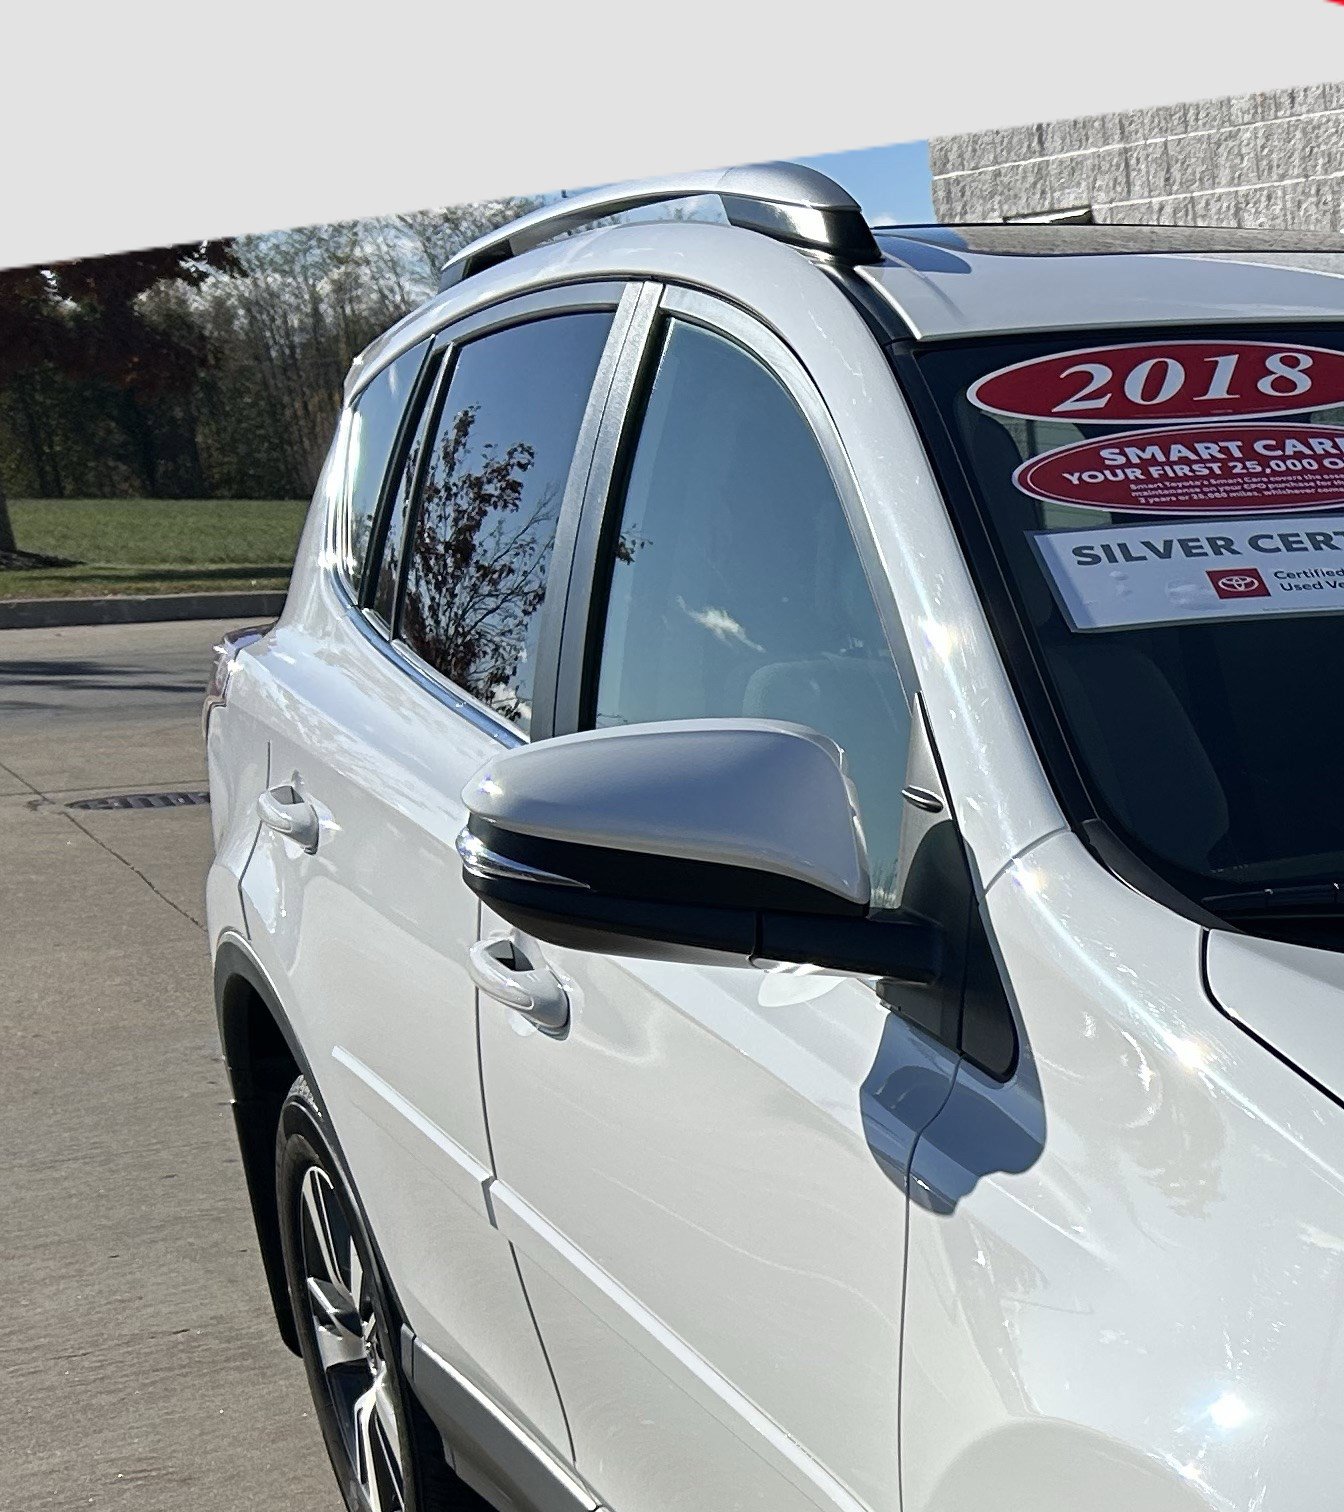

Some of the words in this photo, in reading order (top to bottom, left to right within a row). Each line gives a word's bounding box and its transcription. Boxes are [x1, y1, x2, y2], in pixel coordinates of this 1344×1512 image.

[1052, 352, 1313, 413] 2018
[1100, 441, 1243, 465] SMART
[1062, 467, 1146, 485] YOUR
[1148, 463, 1222, 478] FIRST
[1228, 458, 1319, 474] 25,000
[1072, 533, 1239, 567] SILVER
[1280, 580, 1325, 592] Used
